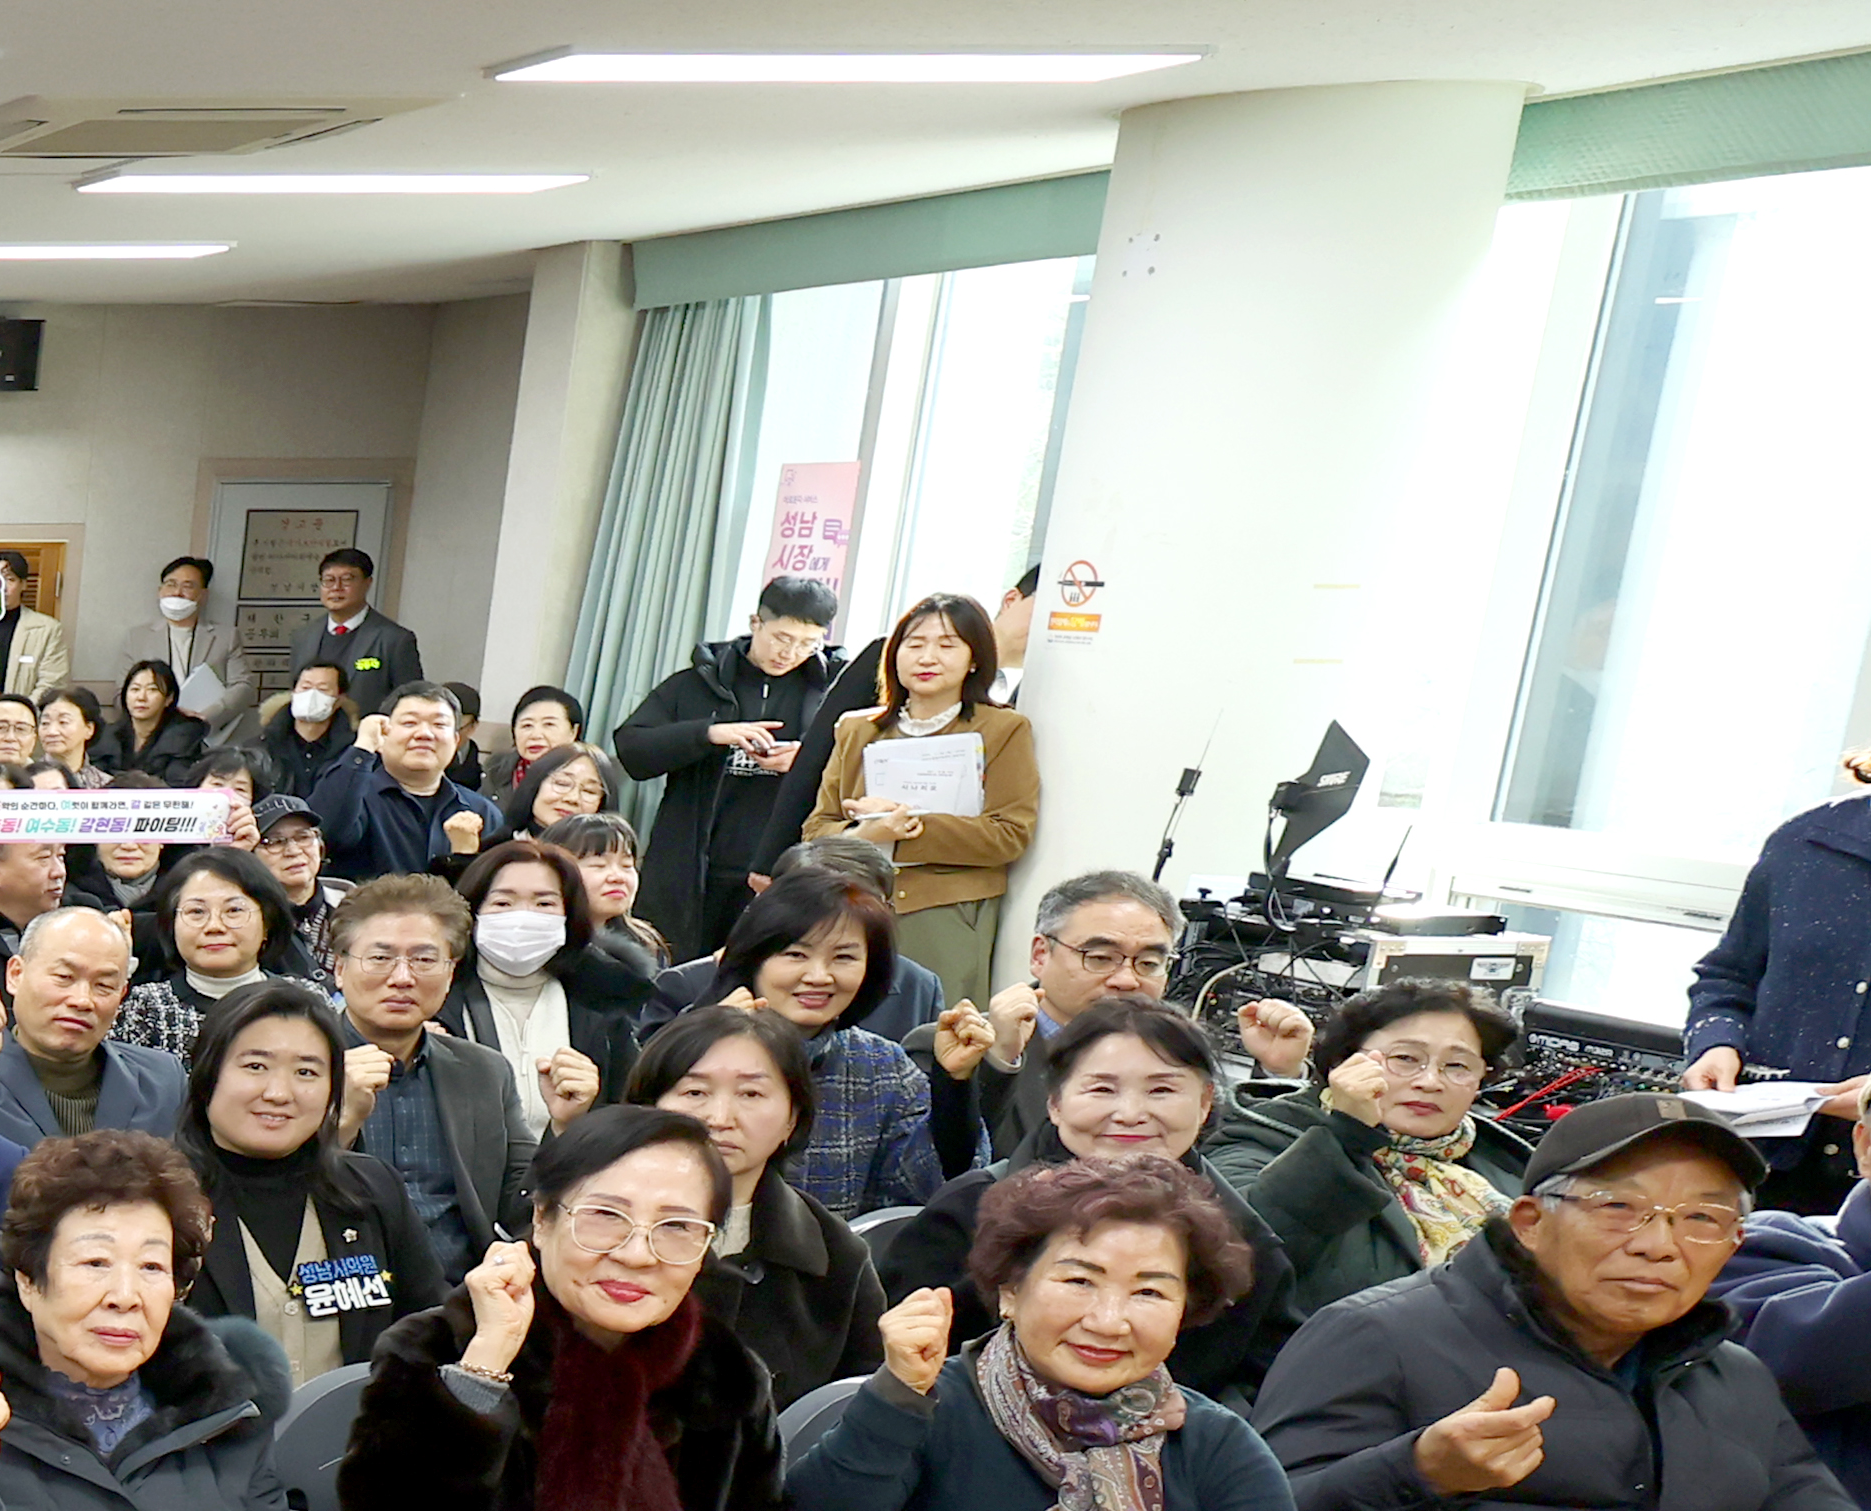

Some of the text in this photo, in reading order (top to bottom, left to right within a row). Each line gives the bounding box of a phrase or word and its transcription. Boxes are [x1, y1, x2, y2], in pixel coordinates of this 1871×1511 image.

[780, 511, 818, 539] 성남
[24, 817, 77, 834] 여수동!
[78, 817, 132, 834] 갈현동!
[133, 817, 198, 833] 파이팅!!!
[298, 1254, 379, 1285] 성남시의원
[303, 1273, 393, 1318] 윤혜선
